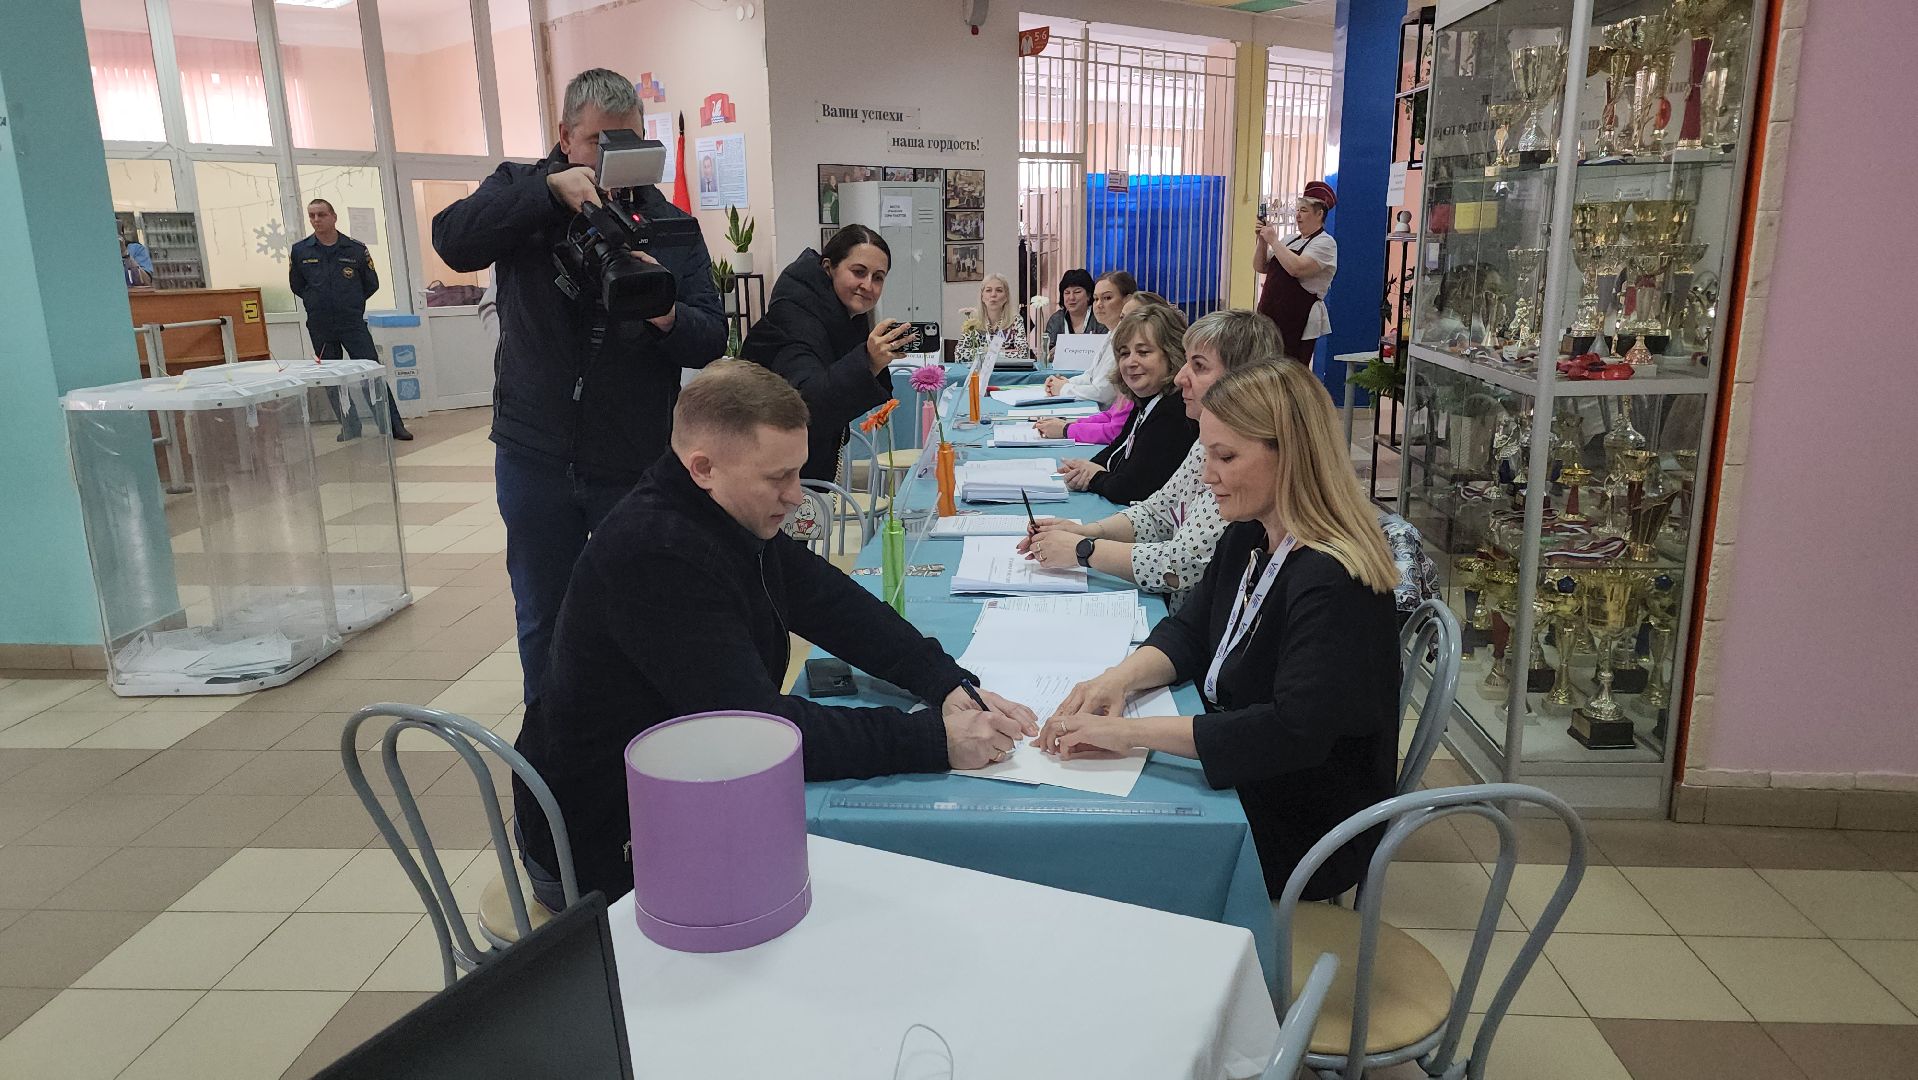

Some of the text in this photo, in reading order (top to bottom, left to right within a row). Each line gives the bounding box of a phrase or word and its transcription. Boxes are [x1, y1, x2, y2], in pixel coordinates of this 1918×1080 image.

[821, 103, 858, 119] Ваши
[862, 108, 904, 123] успехи
[892, 136, 981, 152] наша гордость!
